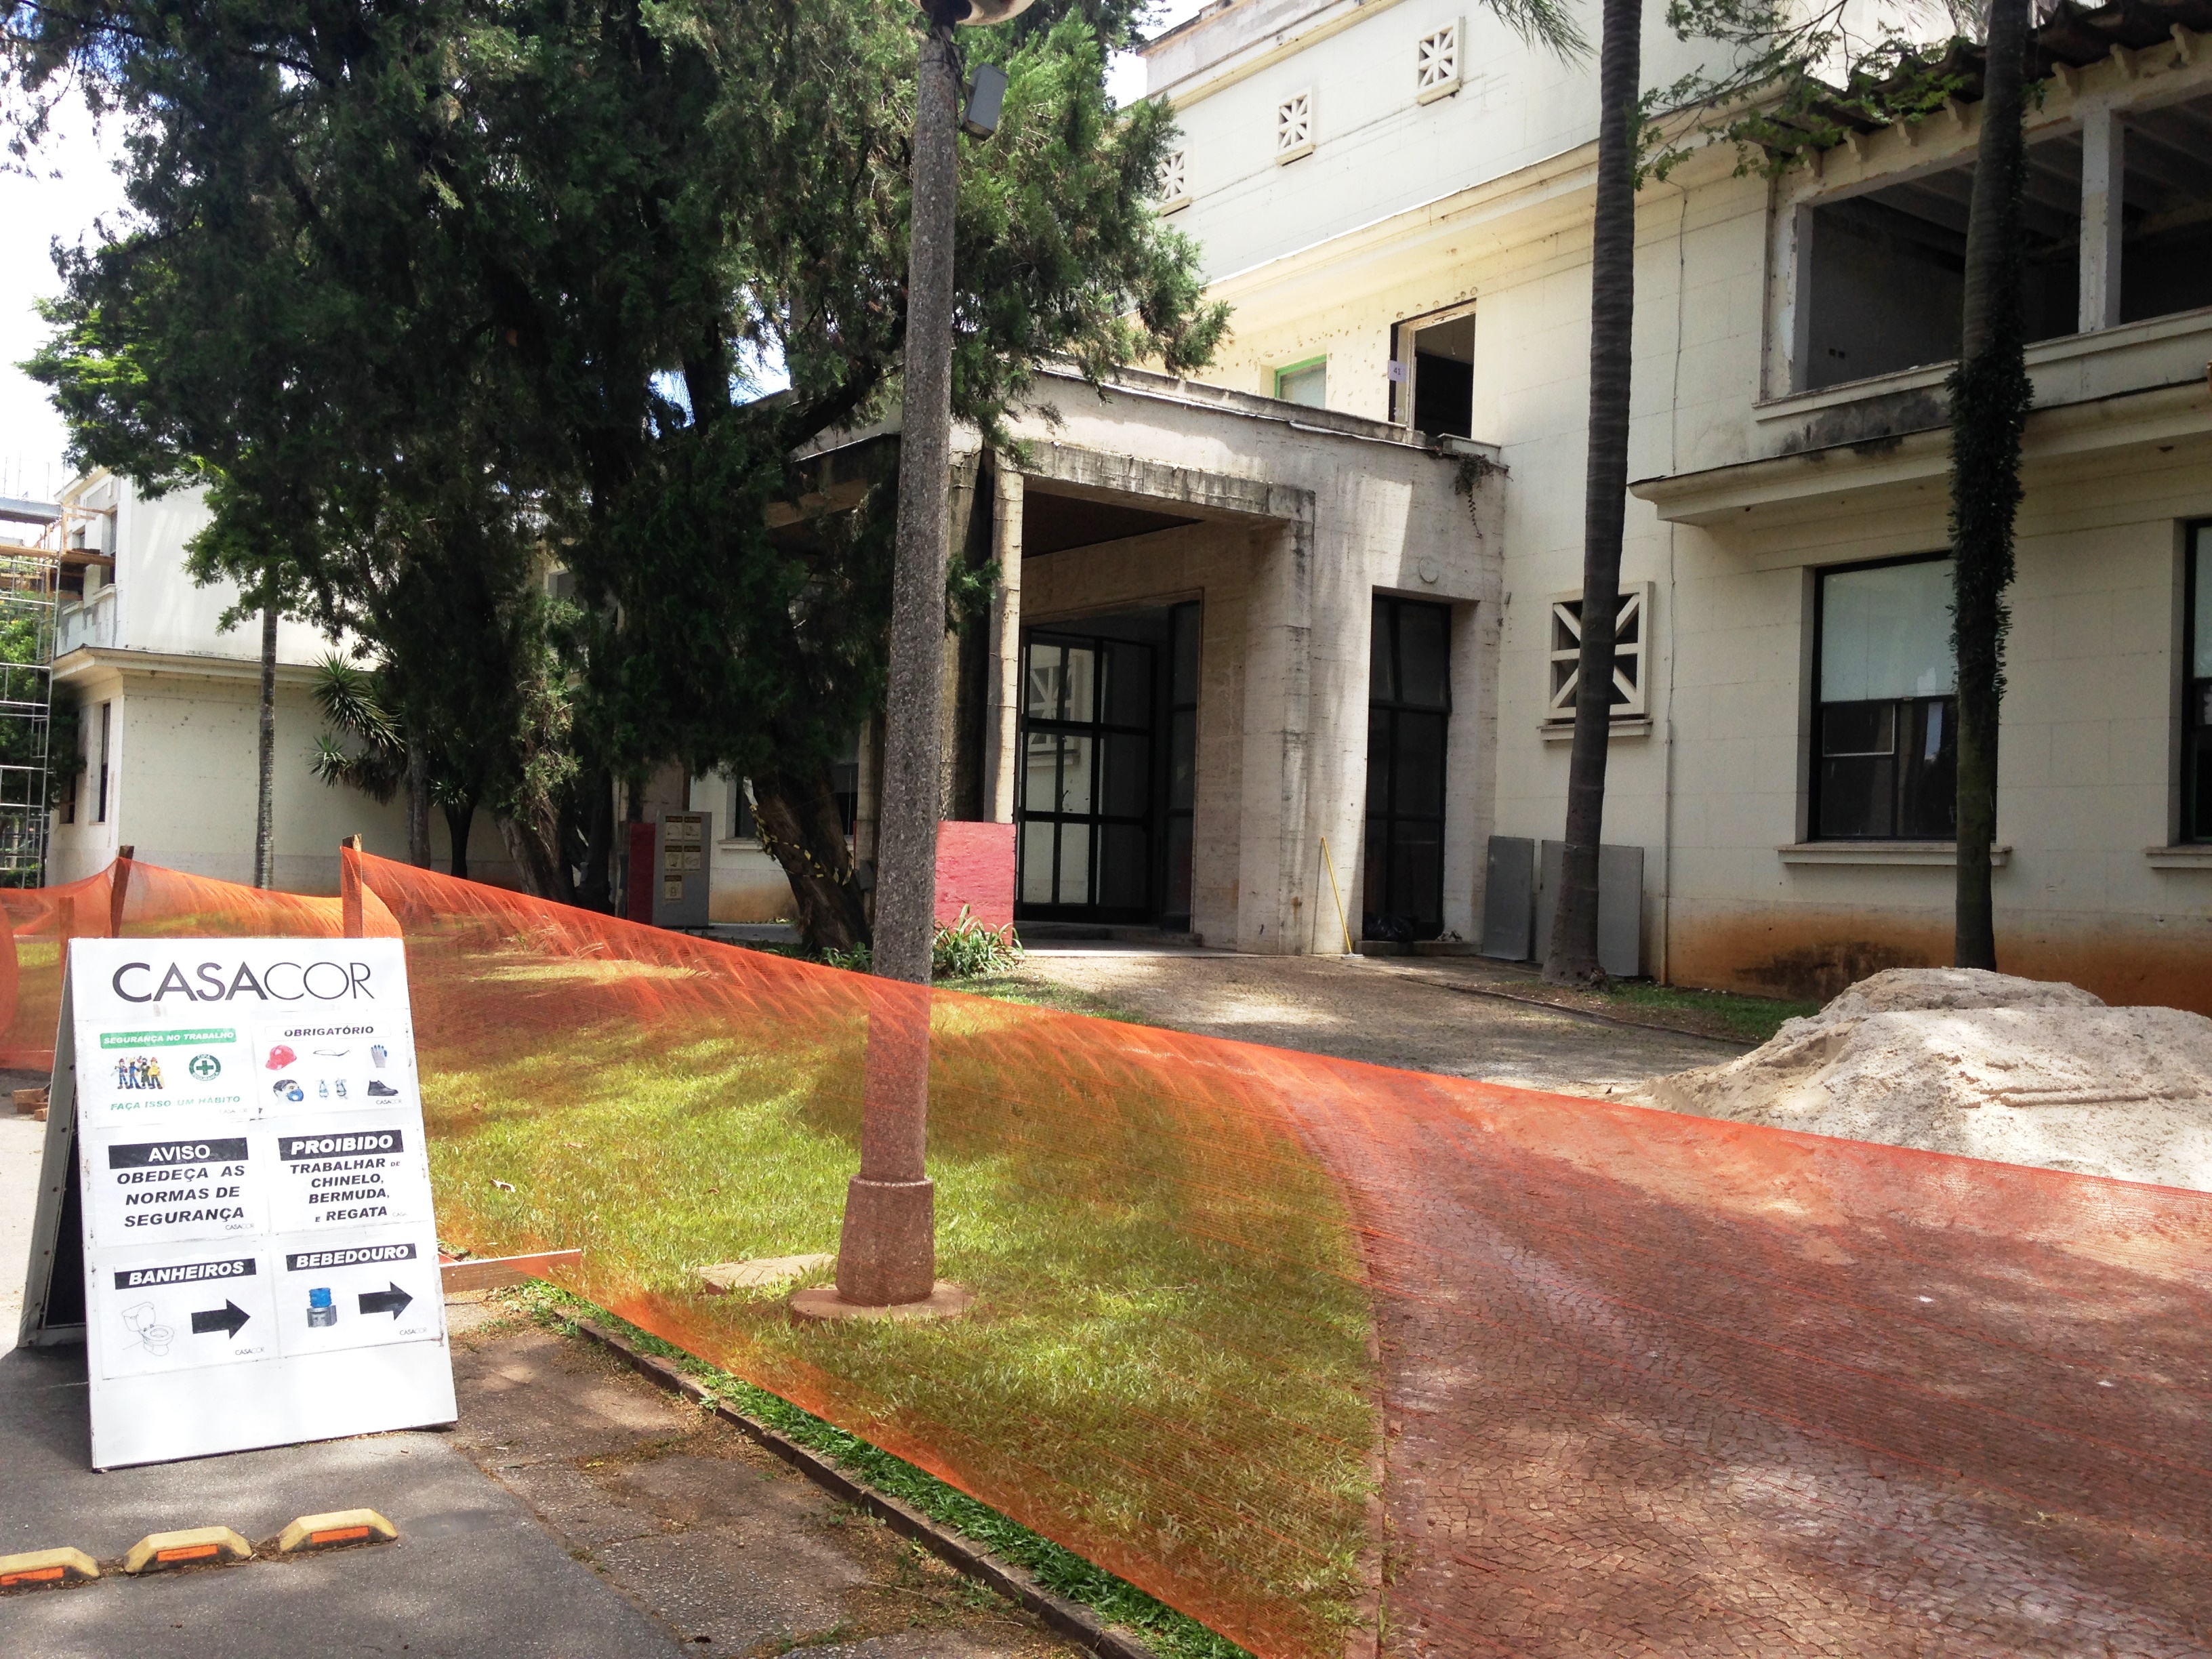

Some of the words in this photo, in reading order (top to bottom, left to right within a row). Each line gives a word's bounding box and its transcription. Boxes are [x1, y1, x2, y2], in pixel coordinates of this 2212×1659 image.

[1393, 367, 1401, 375] 41
[112, 961, 375, 1002] CASACOR
[104, 1033, 164, 1044] SEGURANÇA
[184, 1031, 234, 1041] TRABALHO
[284, 1025, 374, 1037] OBRIGATÓRIO
[110, 1101, 140, 1111] FAÇA
[144, 1100, 171, 1108] ISSO
[291, 1134, 393, 1155] PROIBIDO
[148, 1145, 210, 1162] AVISO
[290, 1158, 386, 1174] TRABALHAR
[117, 1168, 209, 1185] OBEDEÇA
[220, 1165, 245, 1177] AS
[311, 1173, 384, 1188] CHINELO,
[125, 1188, 209, 1205] NORMAS
[216, 1186, 241, 1198] DE
[308, 1188, 390, 1204] BERMUDA,
[124, 1207, 245, 1227] SEGURANÇA
[326, 1206, 388, 1221] REGATA
[295, 1246, 409, 1269] BEBEDOURO
[129, 1261, 245, 1286] BANHEIROS
[399, 1328, 428, 1336] CASACOR
[234, 1347, 265, 1355] CASACOR
